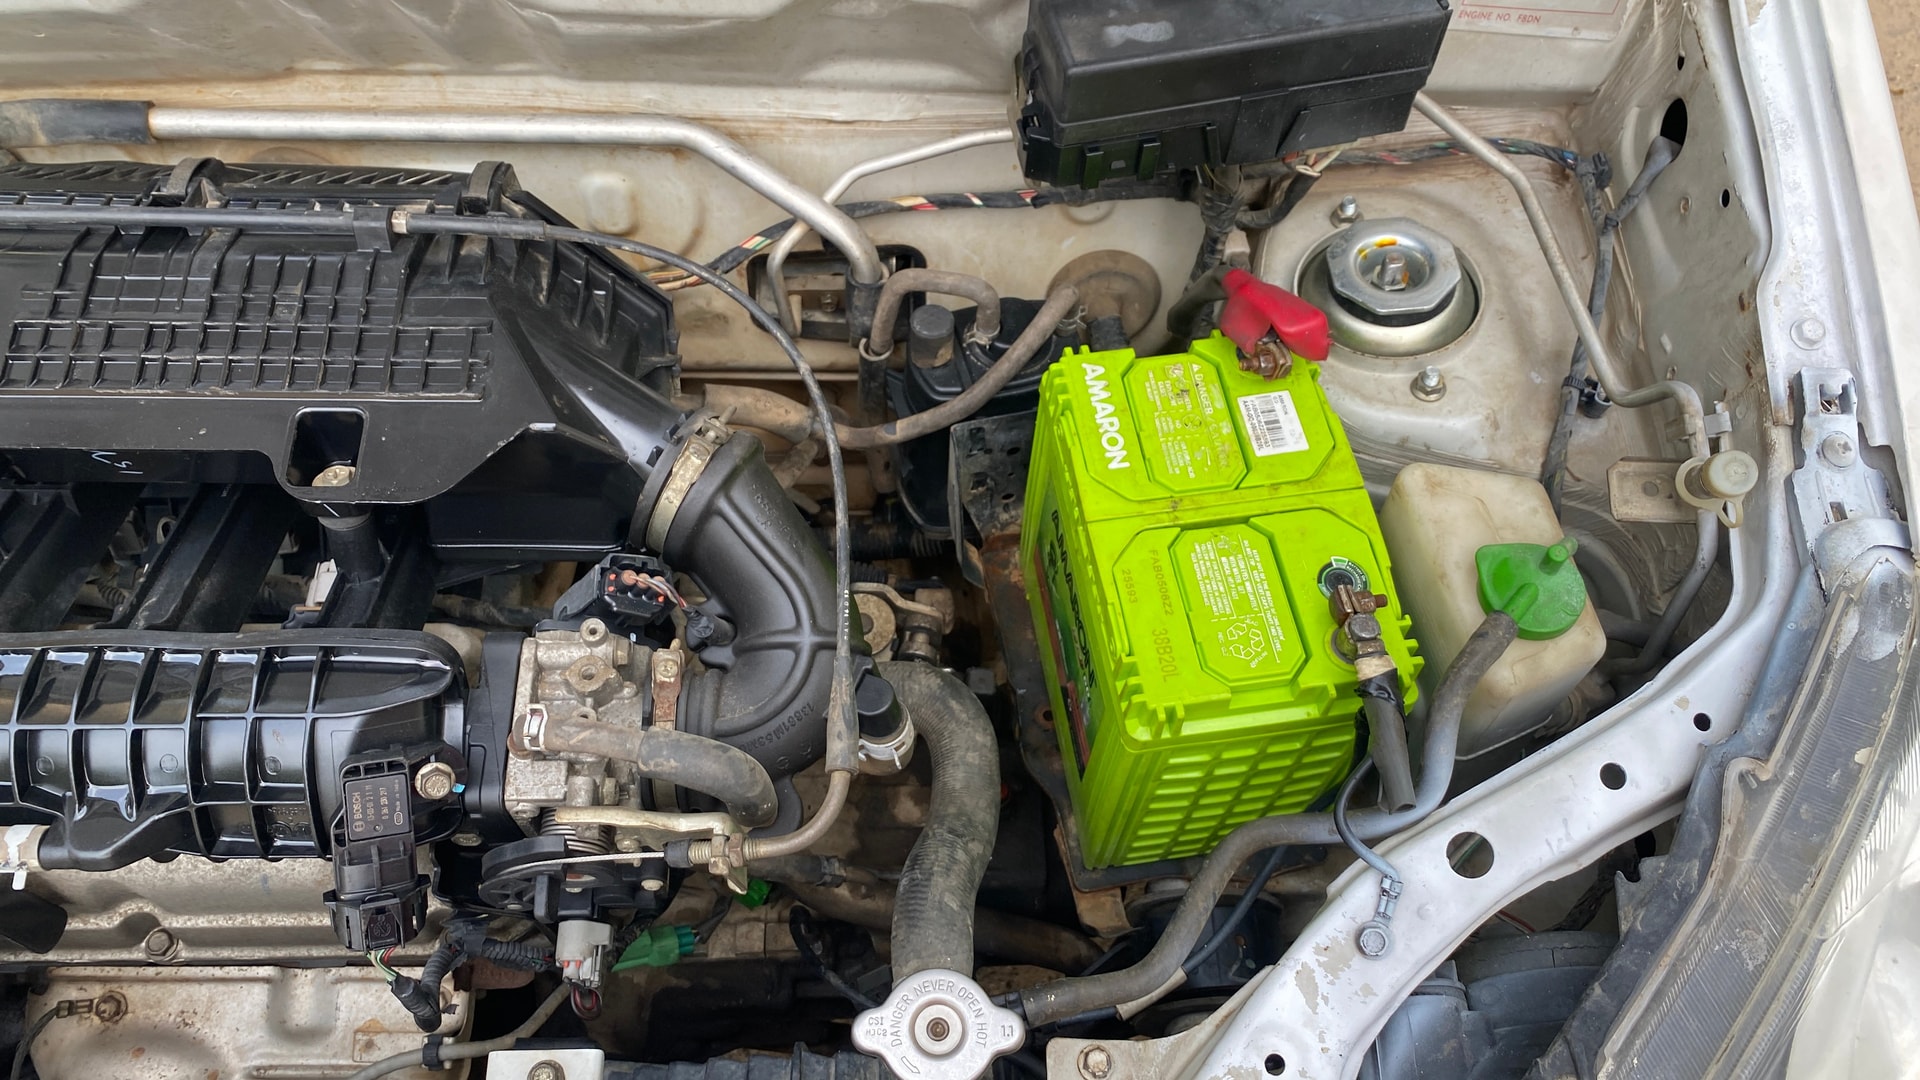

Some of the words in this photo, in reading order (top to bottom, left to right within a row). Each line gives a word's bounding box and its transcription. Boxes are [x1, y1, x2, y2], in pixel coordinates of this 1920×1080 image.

[1458, 10, 1492, 20] ENGINE
[1517, 14, 1541, 23] F8DN
[1194, 372, 1214, 415] DANGER
[1278, 395, 1288, 416] AMARON
[1081, 363, 1130, 469] AMARON
[1122, 568, 1138, 604] 25593
[1240, 568, 1249, 580] EYES
[1251, 549, 1261, 562] KEEP
[1264, 590, 1274, 607] REACH
[1252, 569, 1260, 582] KEEP
[1256, 582, 1264, 595] VENT
[1260, 595, 1269, 608] CAPS
[1152, 628, 1180, 682] 38B20L
[352, 792, 363, 820] BOSCH
[868, 1016, 884, 1026] CSI
[890, 993, 912, 1048] DANGER
[913, 979, 955, 997] NEVER
[957, 986, 984, 1018] OPEN
[976, 1022, 988, 1048] HOT
[1001, 1025, 1014, 1037] 1.1
